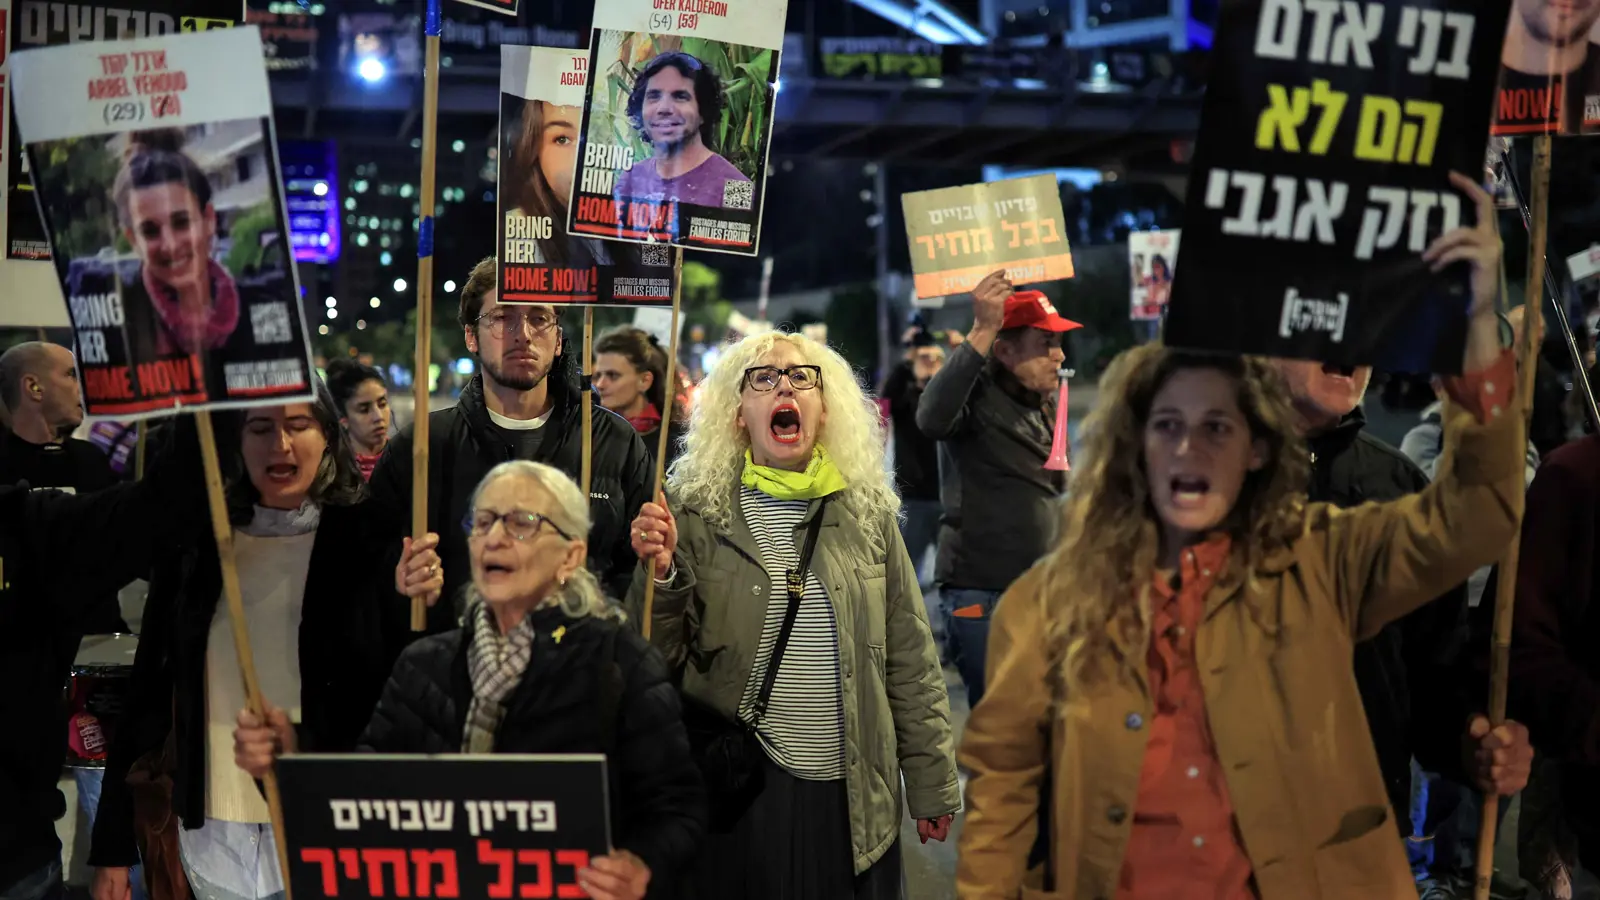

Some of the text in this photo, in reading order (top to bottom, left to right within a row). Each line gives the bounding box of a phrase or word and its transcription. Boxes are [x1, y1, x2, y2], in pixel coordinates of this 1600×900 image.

[649, 13, 673, 31] (54)
[653, 0, 728, 17] OFER KALDERON
[677, 13, 698, 30] (53)
[1254, 0, 1475, 79] בני אדם
[103, 101, 145, 125] (29)
[1254, 78, 1443, 166] הם לא
[583, 142, 634, 171] BRING
[580, 167, 614, 195] HIM
[577, 196, 675, 231] HOME NOW!
[994, 196, 1039, 218] פדיון
[1204, 168, 1349, 244] אגבי
[505, 215, 553, 240] BRING
[690, 225, 750, 244] FAMILIES FORUM
[691, 216, 751, 232] HOSTAGES AND MISSING
[504, 239, 536, 264] HER
[916, 218, 1061, 260] בכל מחיר
[504, 266, 598, 293] HOME NOW!
[613, 277, 670, 287] HOSTAGES AND MISSING
[613, 285, 670, 298] FAMILIES FORUM
[69, 292, 125, 328] BRING
[79, 330, 109, 364] HER
[137, 353, 203, 397] NOW!
[329, 800, 557, 836] פדיון שבויים
[300, 848, 460, 898] מחיר
